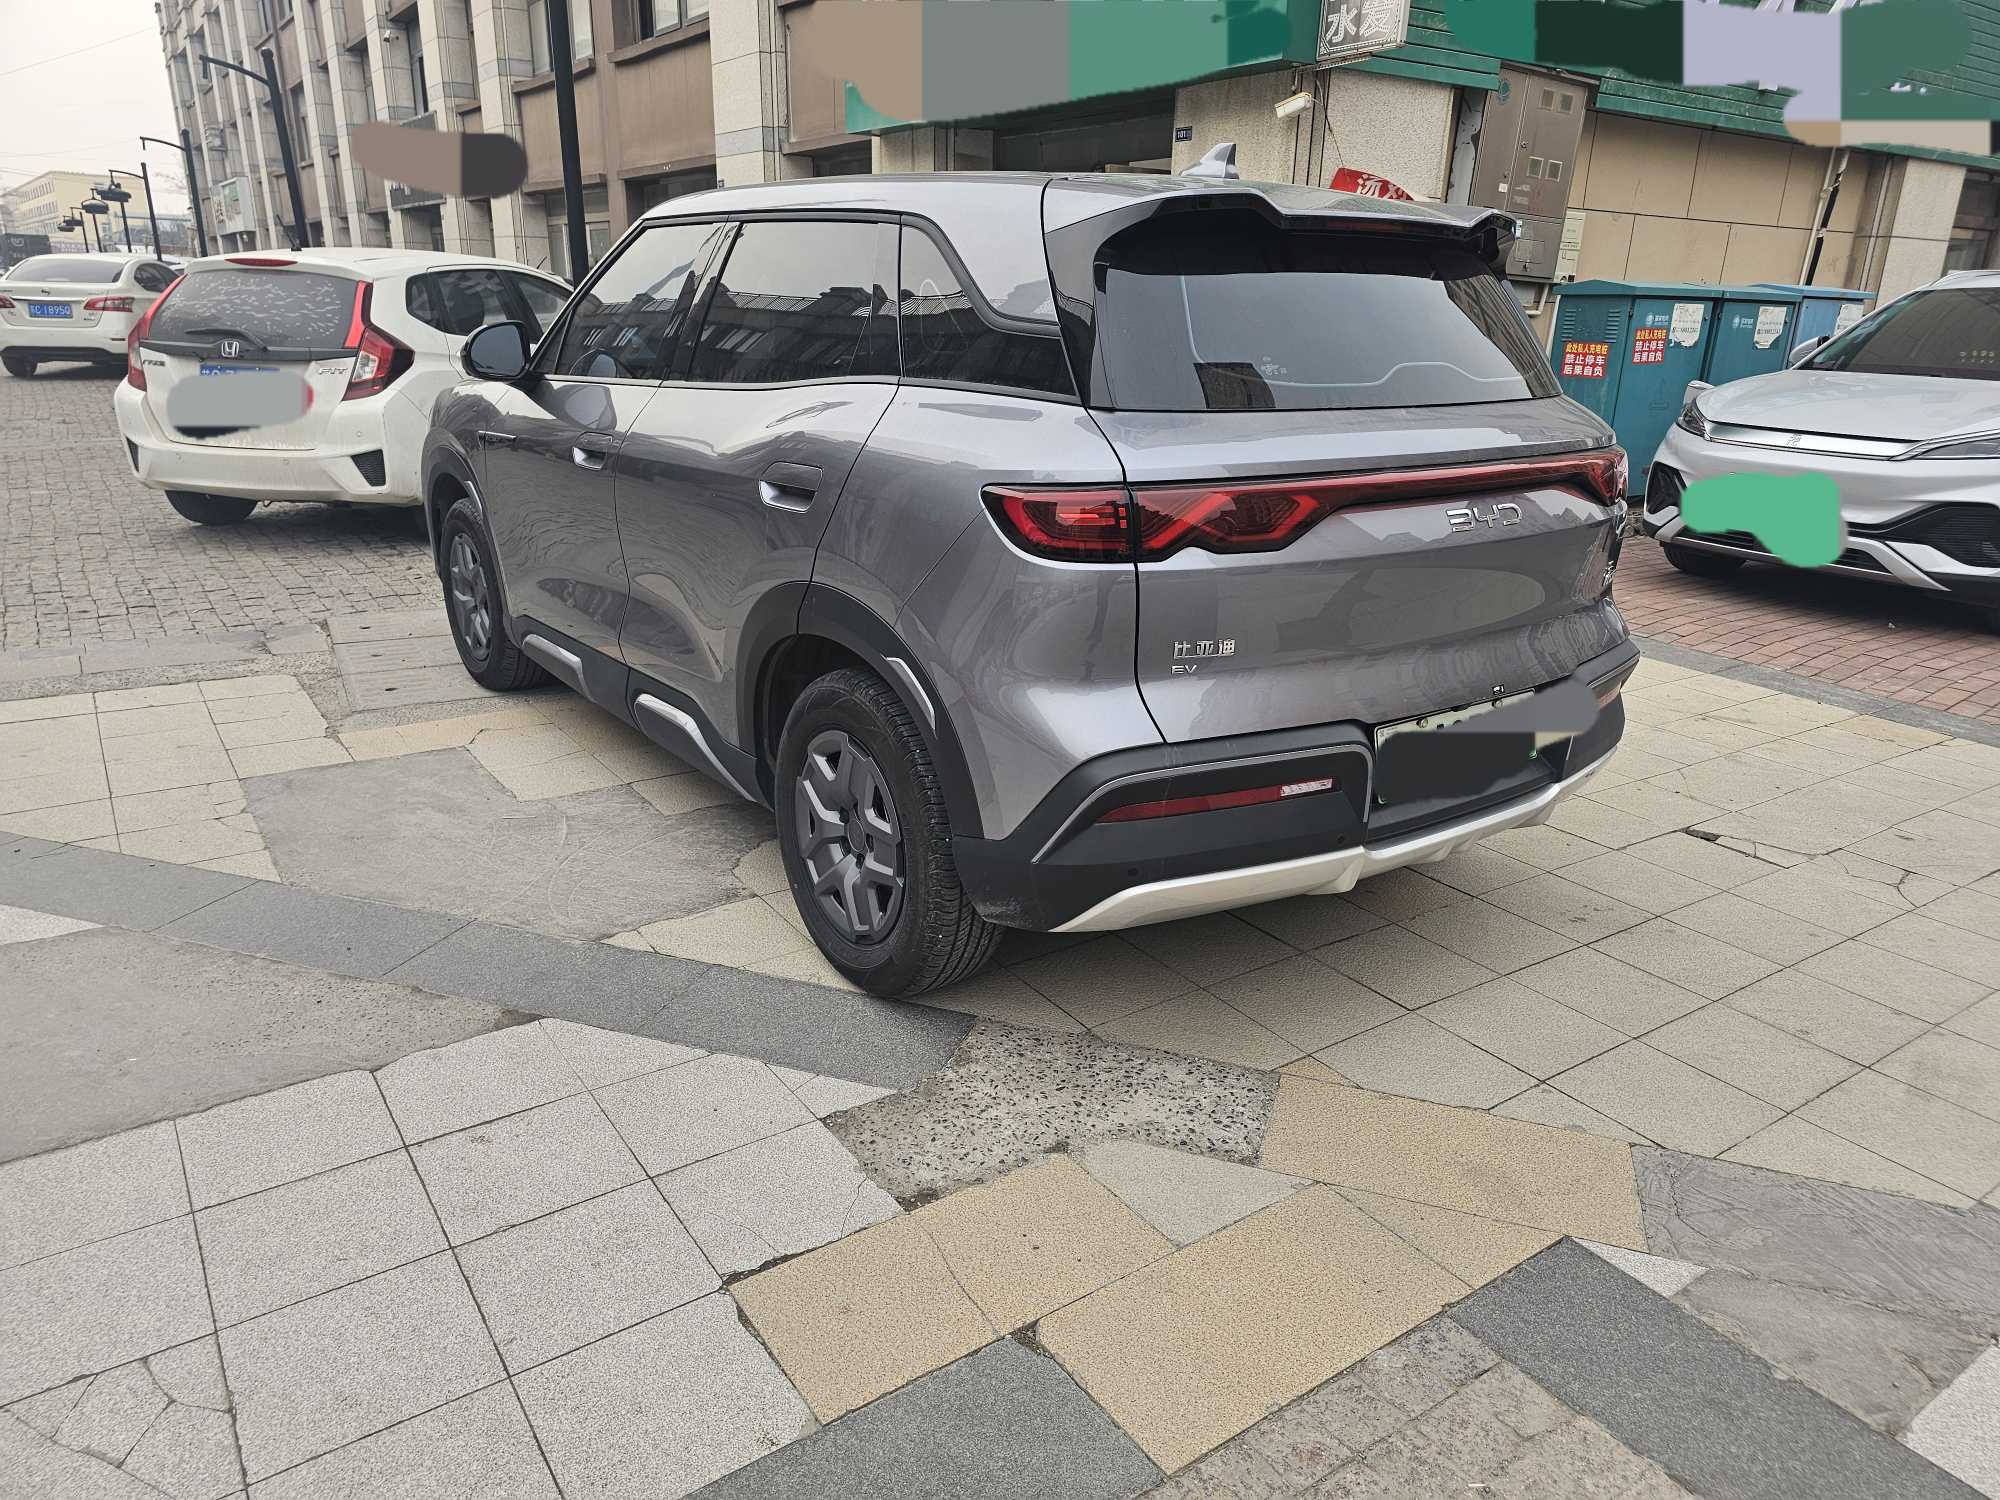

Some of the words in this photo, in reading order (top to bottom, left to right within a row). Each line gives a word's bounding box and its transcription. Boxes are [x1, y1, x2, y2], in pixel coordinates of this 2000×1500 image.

[1635, 340, 1664, 352] 禁止停车
[1565, 353, 1605, 366] 禁止停车
[1633, 351, 1662, 362] 后果自负
[1563, 364, 1603, 377] 后果自负
[1446, 503, 1523, 533] BYD
[1173, 638, 1236, 660] 比亚迪
[1171, 664, 1198, 675] EV
